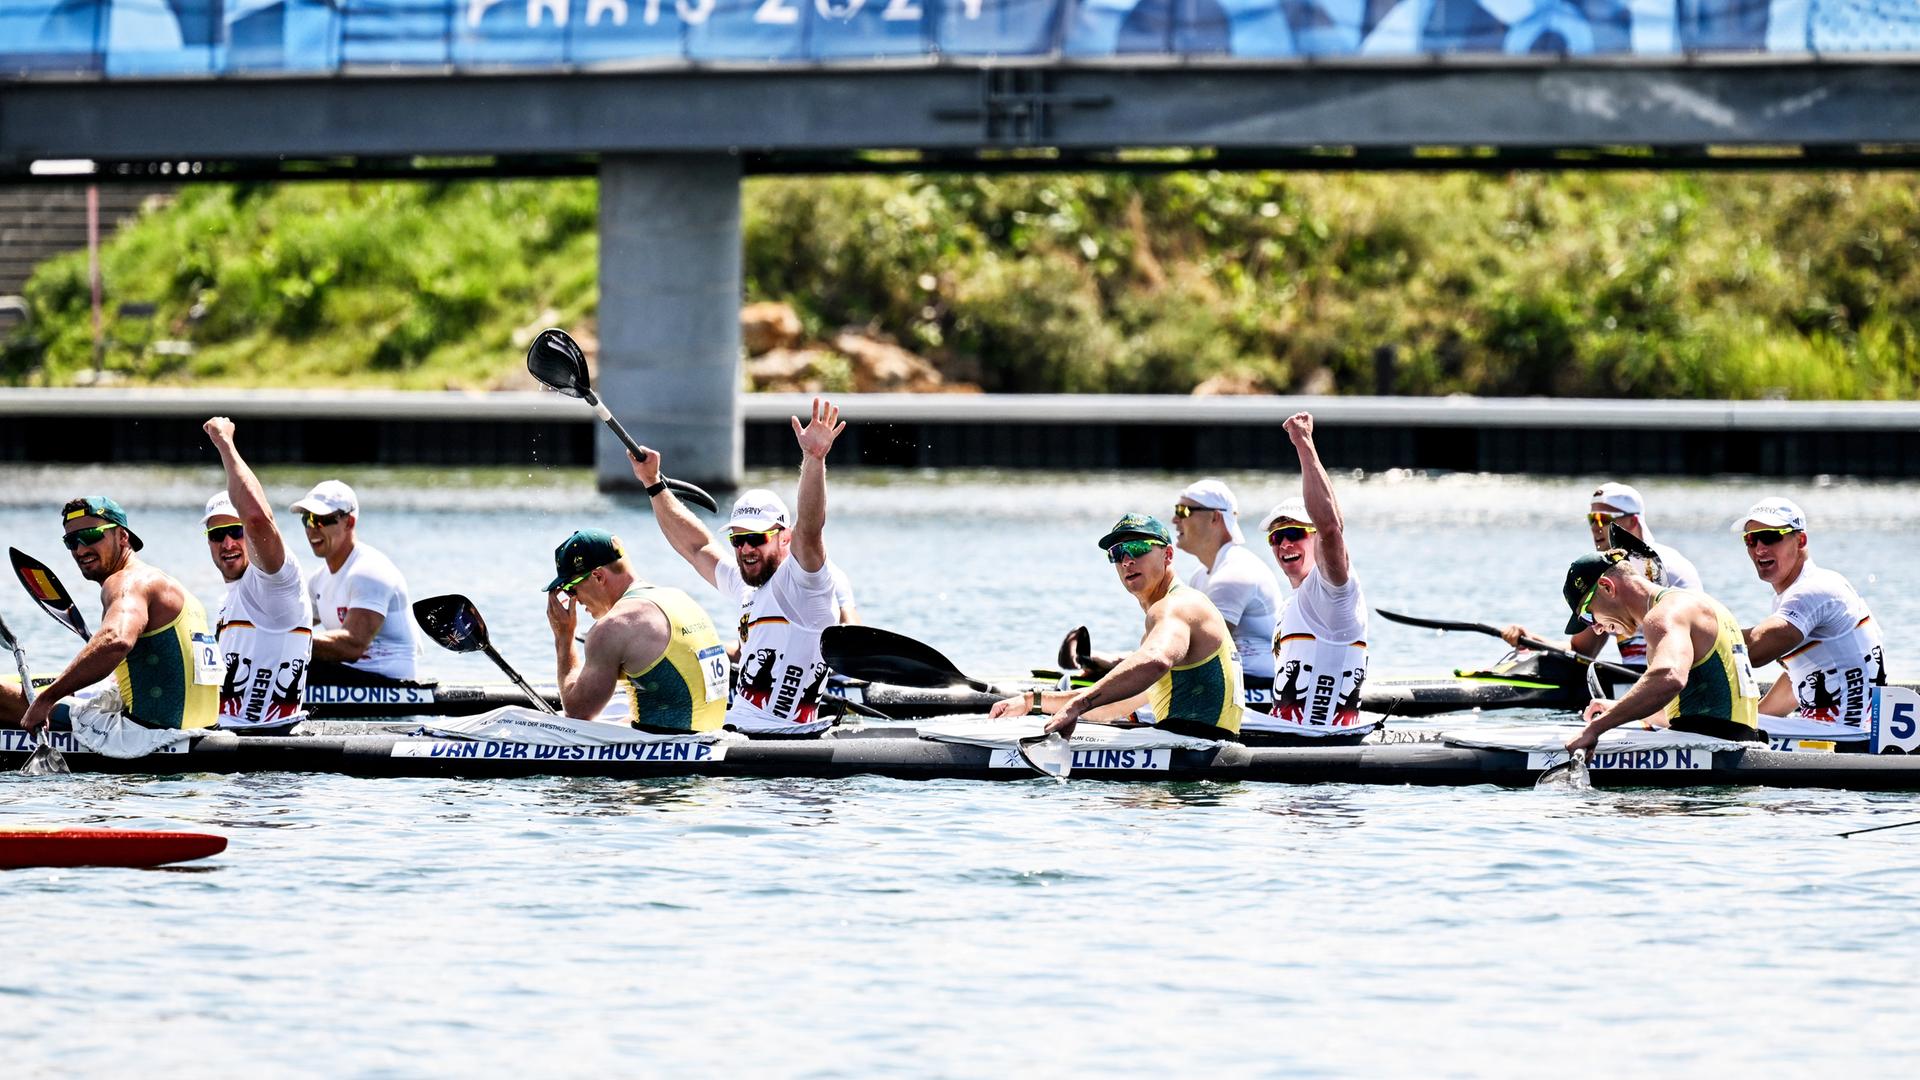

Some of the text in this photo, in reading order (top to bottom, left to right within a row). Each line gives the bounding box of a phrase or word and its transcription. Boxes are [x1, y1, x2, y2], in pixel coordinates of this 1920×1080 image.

[710, 657, 724, 679] 16
[245, 668, 273, 723] GERMA
[406, 687, 424, 703] S.
[772, 664, 804, 719] GERMA
[1310, 674, 1336, 726] GERMA
[1843, 667, 1864, 728] GERMAN
[1889, 703, 1916, 739] 5
[430, 742, 713, 761] VAN DER WESTHUYZEN P.
[1072, 750, 1158, 769] LLINS J.
[1586, 748, 1699, 769] AVARD N.
